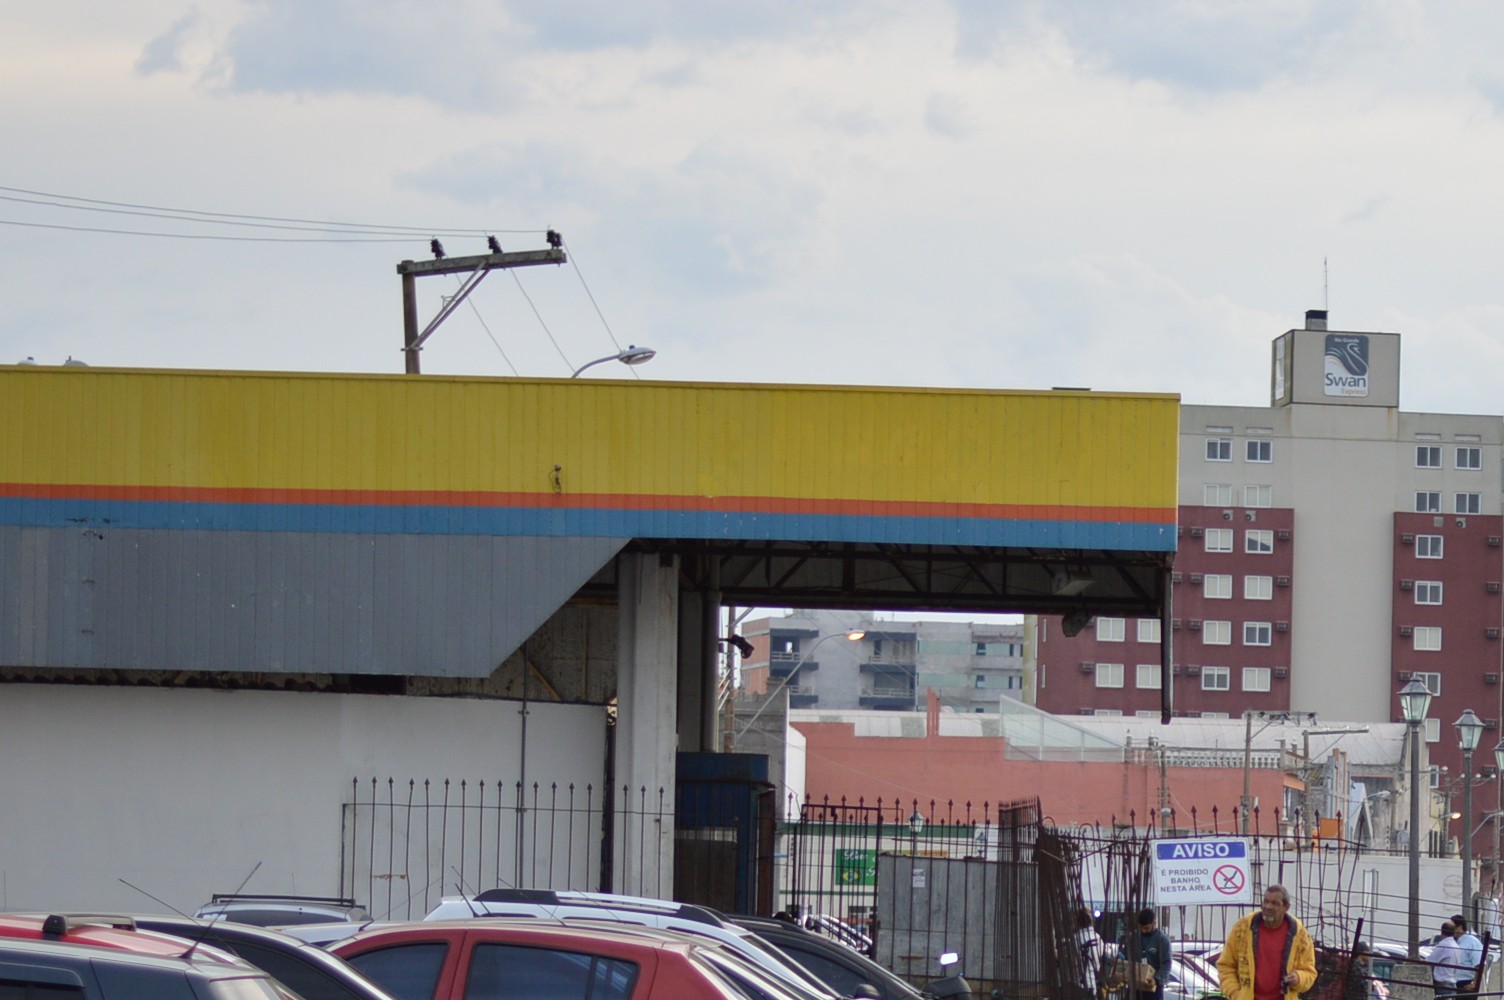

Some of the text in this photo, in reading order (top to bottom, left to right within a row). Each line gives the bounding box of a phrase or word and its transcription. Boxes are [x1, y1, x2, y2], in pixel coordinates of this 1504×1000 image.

[1325, 372, 1367, 388] Swan
[1172, 843, 1230, 858] AVISO
[1168, 868, 1209, 876] PROIBIDO
[1160, 884, 1212, 893] NESTA ÁREA
